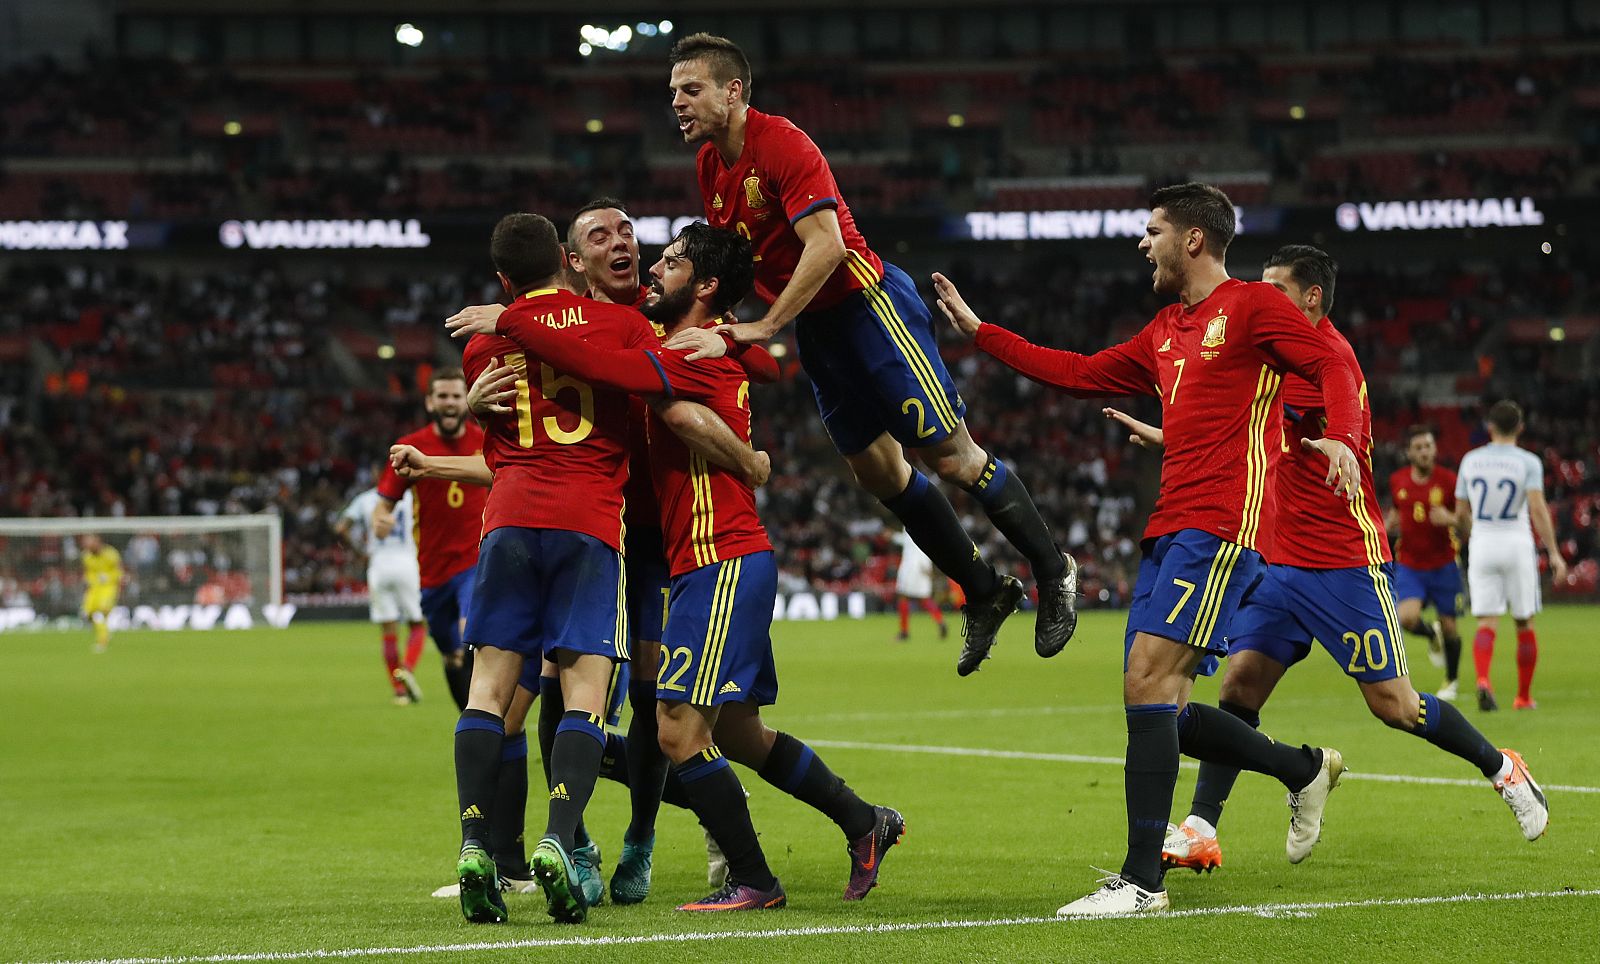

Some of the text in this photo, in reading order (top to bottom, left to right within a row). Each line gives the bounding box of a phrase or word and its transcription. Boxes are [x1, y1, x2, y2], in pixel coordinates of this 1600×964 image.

[103, 220, 128, 249] X
[243, 219, 430, 248] VAUXHALL
[966, 211, 1027, 240] THE
[1029, 210, 1103, 239] NEW
[1359, 196, 1544, 231] VAUXHALL
[504, 352, 594, 448] 15
[1170, 358, 1186, 405] 7
[901, 397, 938, 439] 2
[447, 481, 464, 508] 6
[1472, 478, 1518, 521] 22
[1165, 578, 1196, 624] 7
[657, 644, 693, 692] 22
[1342, 628, 1388, 672] 20
